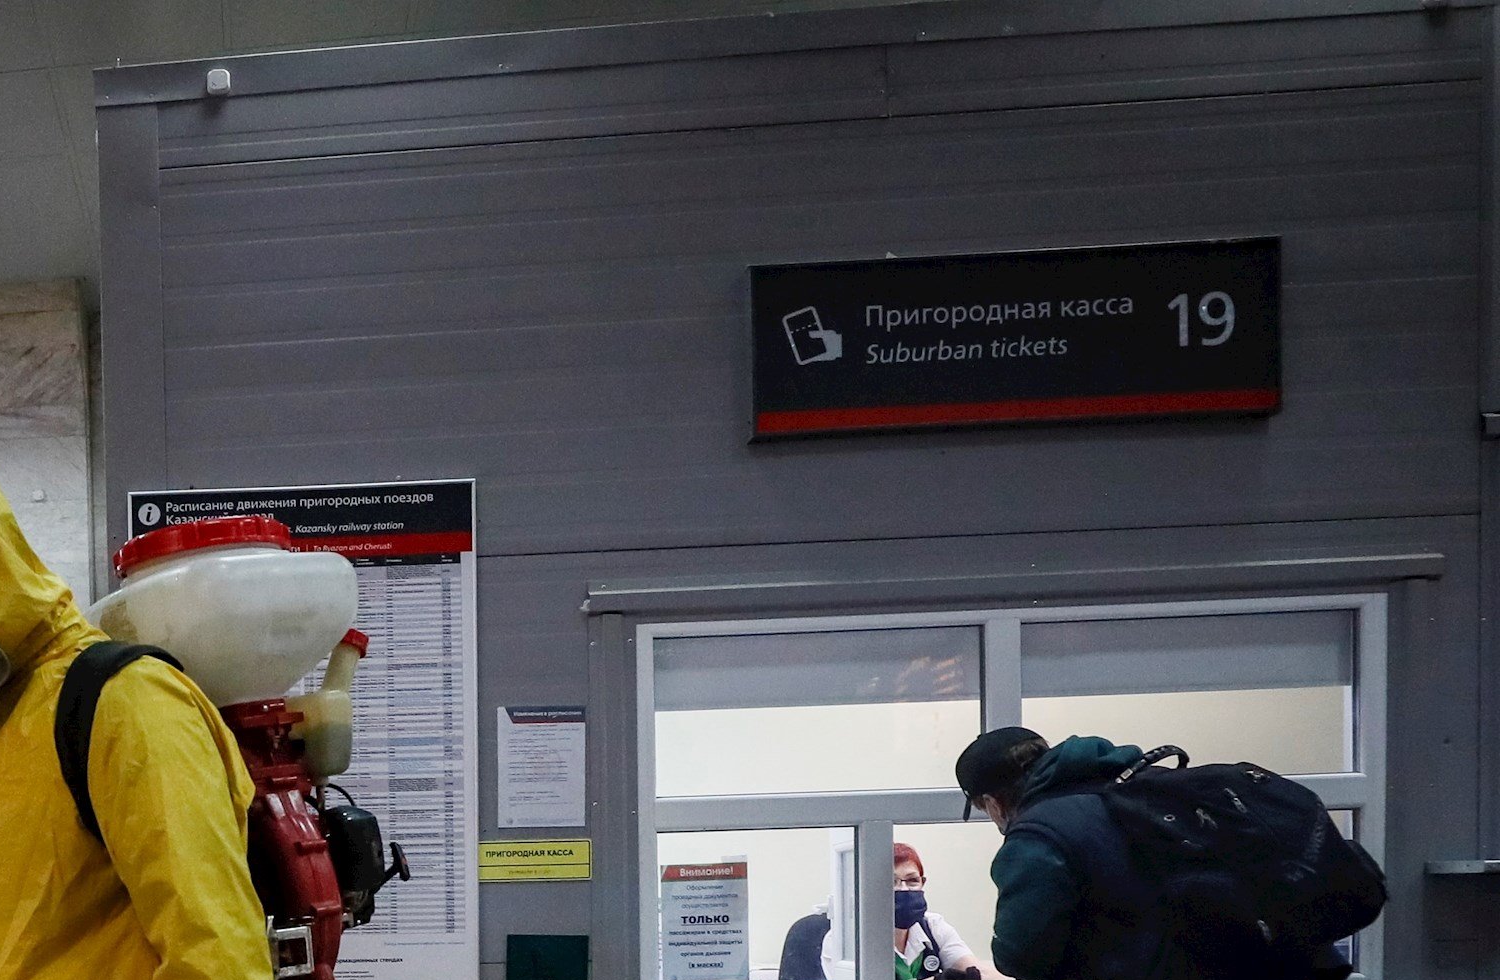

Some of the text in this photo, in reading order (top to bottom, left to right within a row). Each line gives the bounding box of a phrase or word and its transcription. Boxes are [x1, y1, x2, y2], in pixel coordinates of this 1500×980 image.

[864, 296, 1134, 332] Пригородная касса
[1167, 291, 1236, 347] 19
[865, 335, 1068, 364] Suburban tickets
[165, 493, 434, 513] Расписание движения пригородных поездов
[295, 523, 337, 534] Kazansky
[338, 522, 372, 533] railway
[373, 520, 405, 531] station
[322, 544, 348, 552] Ryazan
[349, 543, 363, 551] and
[364, 542, 393, 551] Cherusti
[485, 849, 574, 859] ПРИГОРОДНАЯ КАССА
[679, 866, 734, 877] Внимание!
